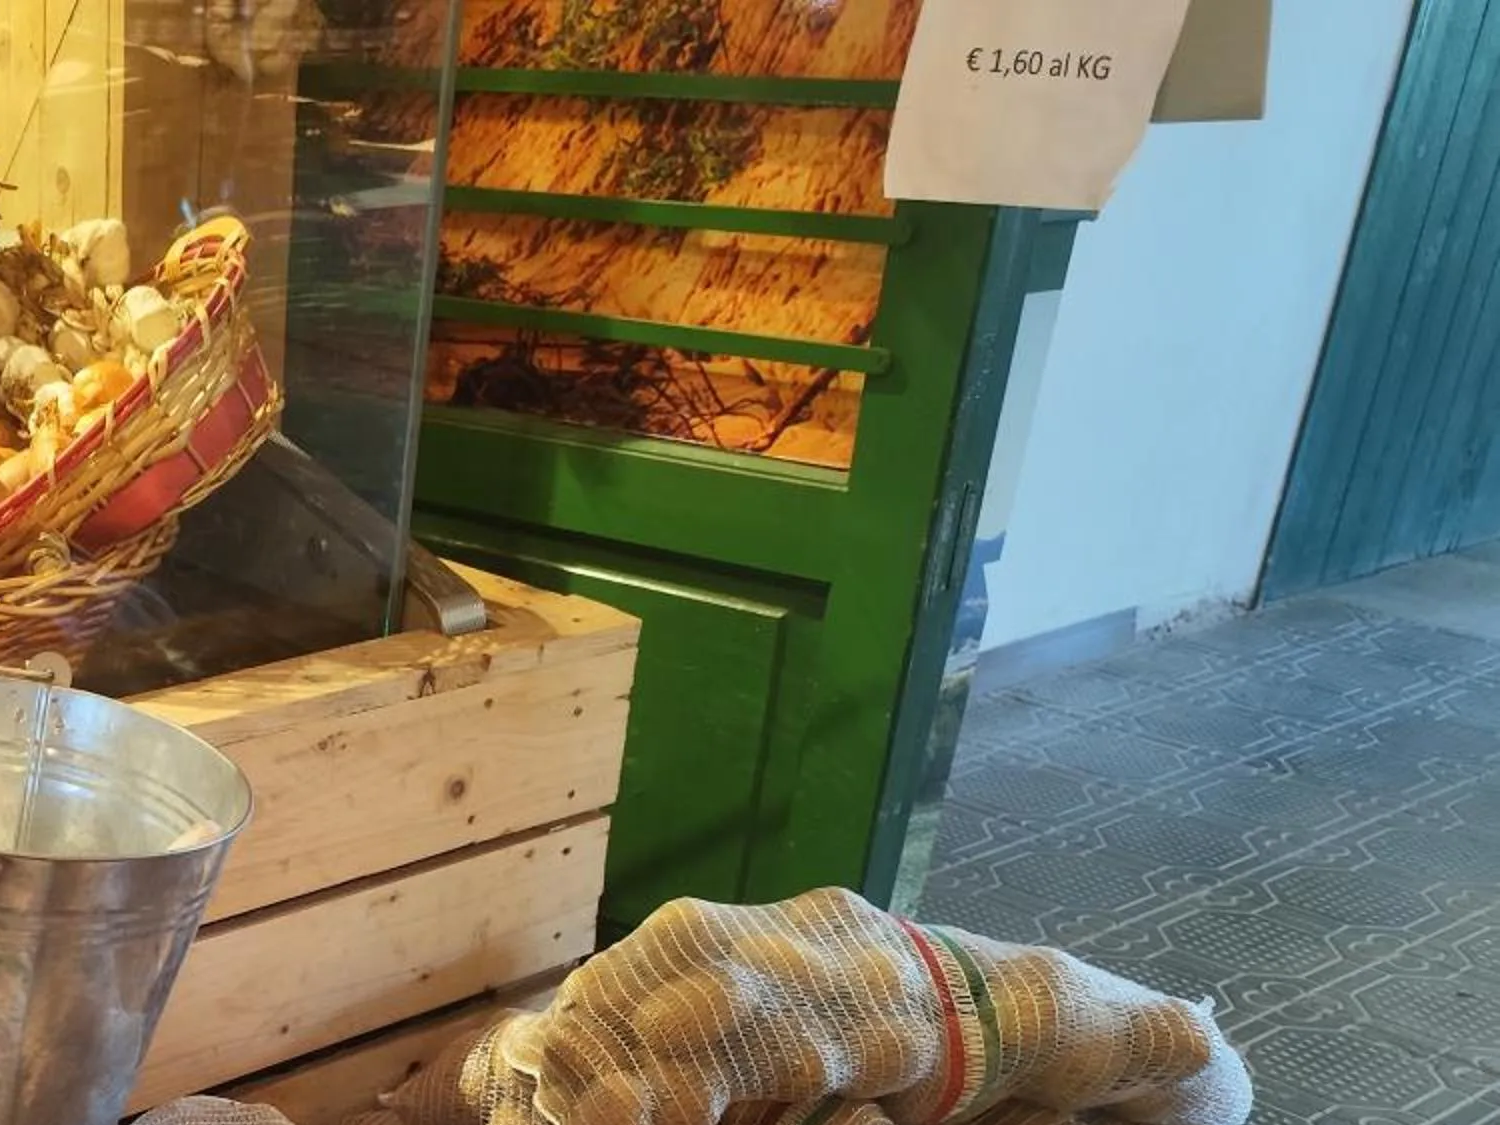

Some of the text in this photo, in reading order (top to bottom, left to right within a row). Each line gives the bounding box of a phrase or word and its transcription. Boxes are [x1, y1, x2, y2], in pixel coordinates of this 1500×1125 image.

[966, 48, 1111, 80] € 1,60 al KG
